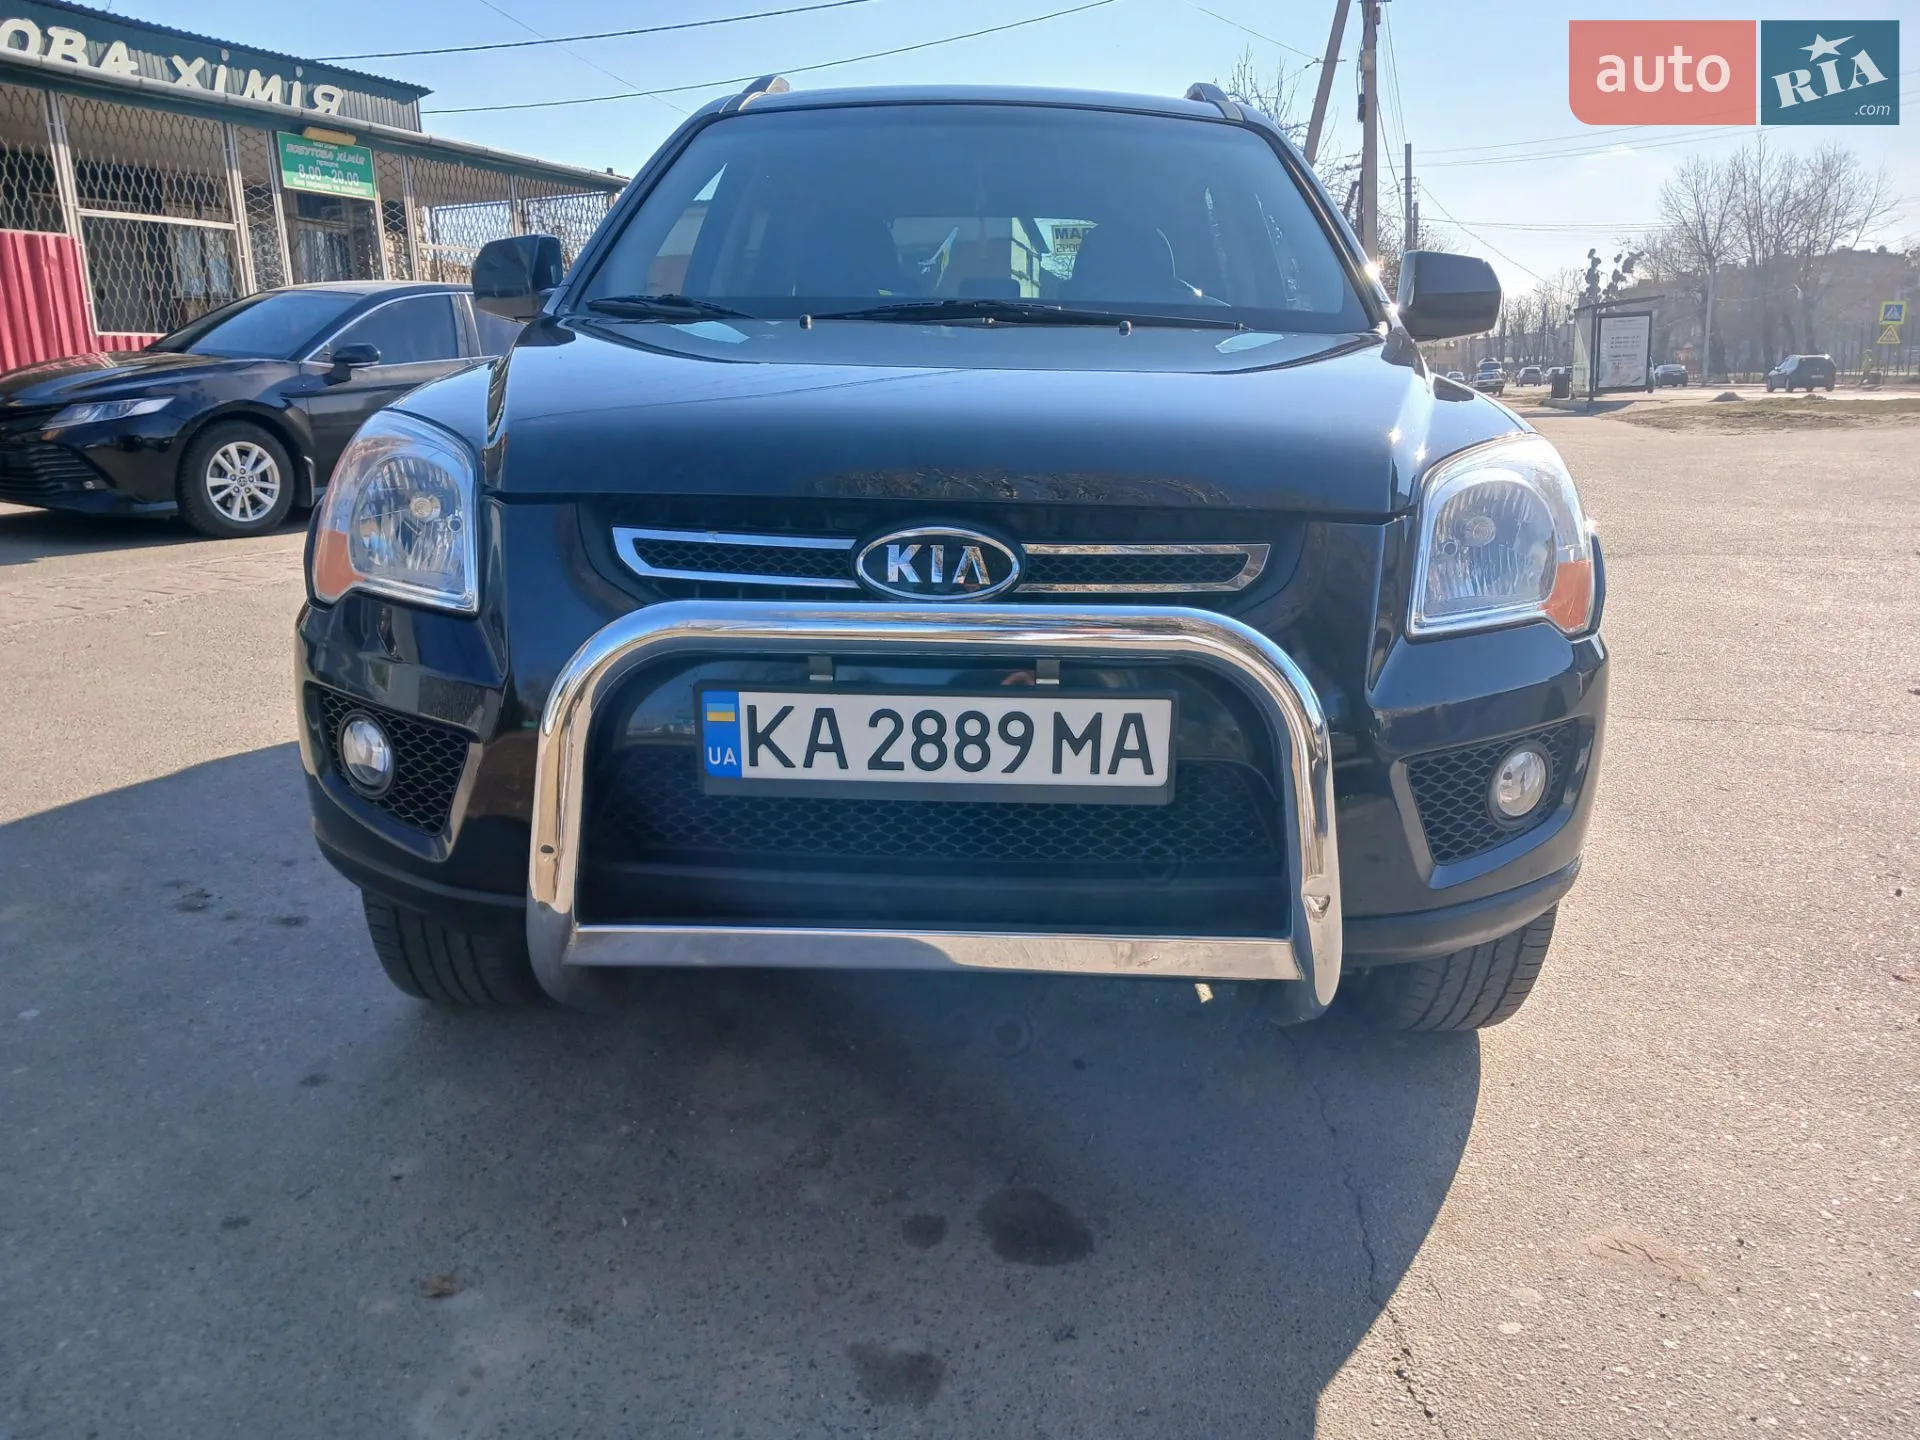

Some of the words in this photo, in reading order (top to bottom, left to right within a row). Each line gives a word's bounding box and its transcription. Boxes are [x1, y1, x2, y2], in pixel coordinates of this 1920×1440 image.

[298, 164, 322, 181] 8.00
[331, 169, 360, 187] 20.00
[886, 544, 991, 585] KIA
[746, 704, 849, 770] KA
[867, 708, 1035, 774] 2889
[1052, 710, 1155, 776] MA
[707, 747, 738, 767] UA
